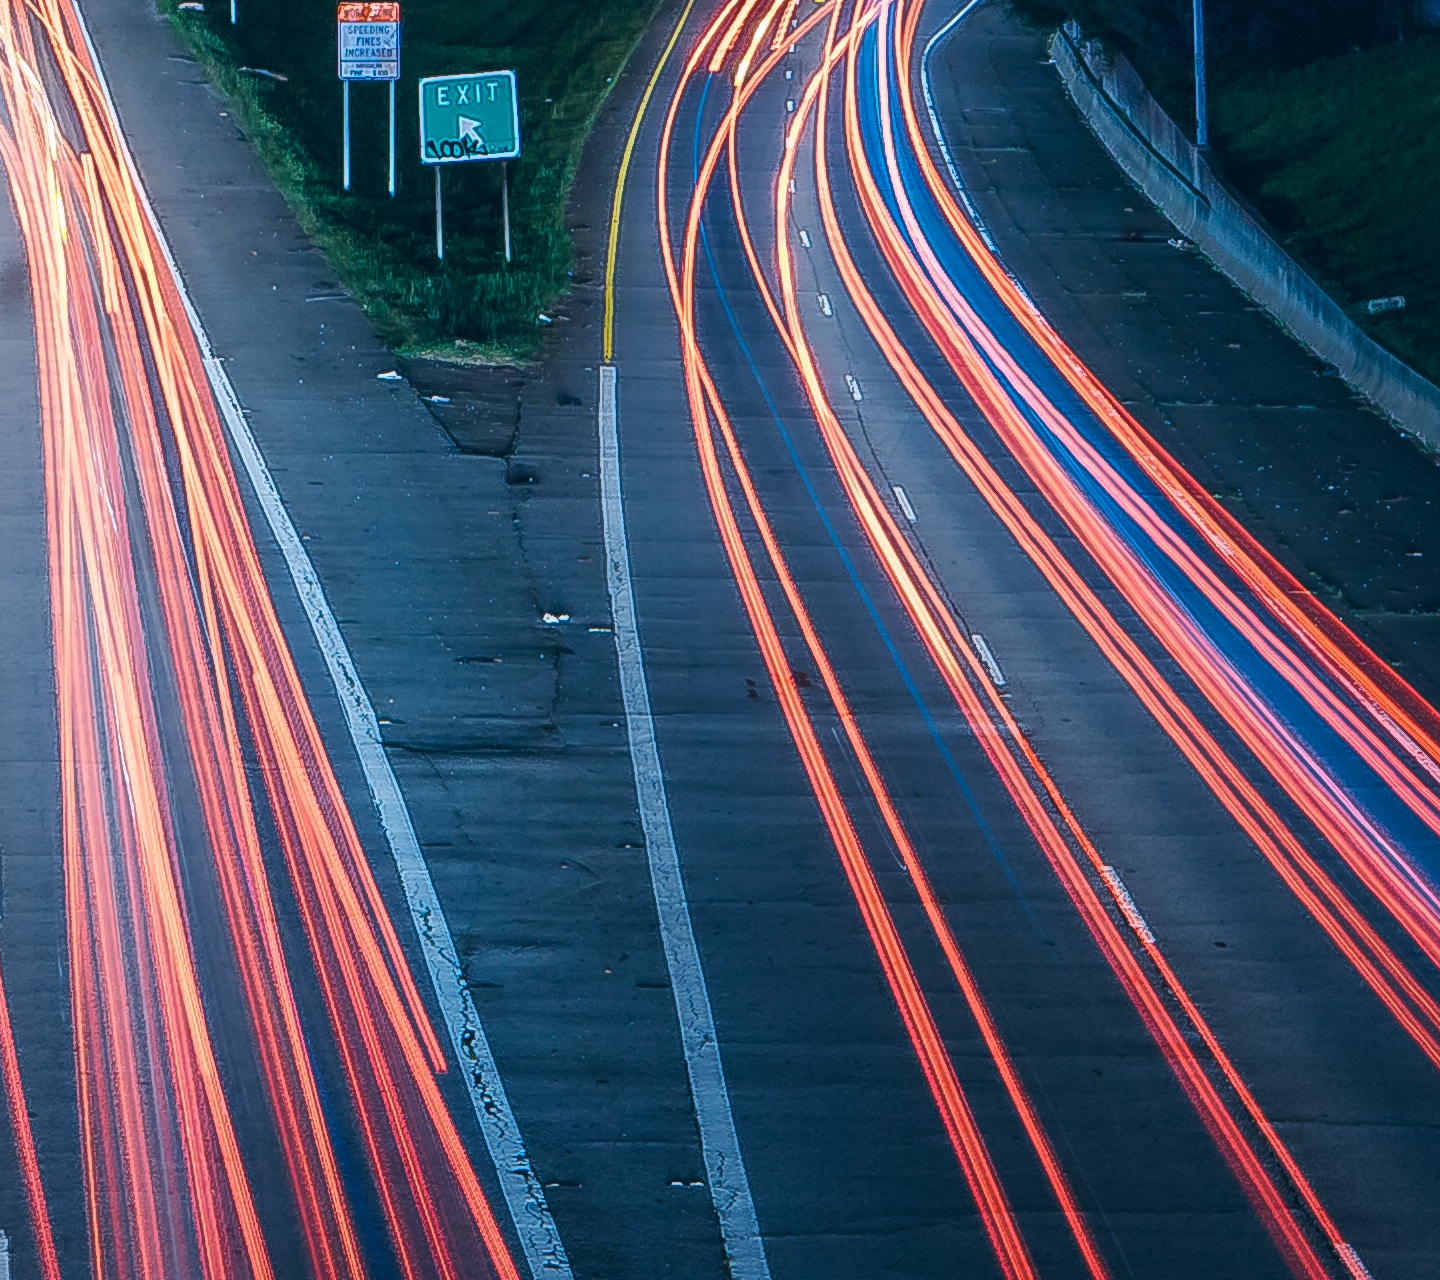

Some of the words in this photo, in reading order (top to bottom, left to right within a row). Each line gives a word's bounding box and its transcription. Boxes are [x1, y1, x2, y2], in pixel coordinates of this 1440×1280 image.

[347, 24, 391, 35] SPEEDING
[356, 36, 382, 47] FINES
[345, 47, 393, 58] INCREASED
[437, 81, 498, 106] EXIT
